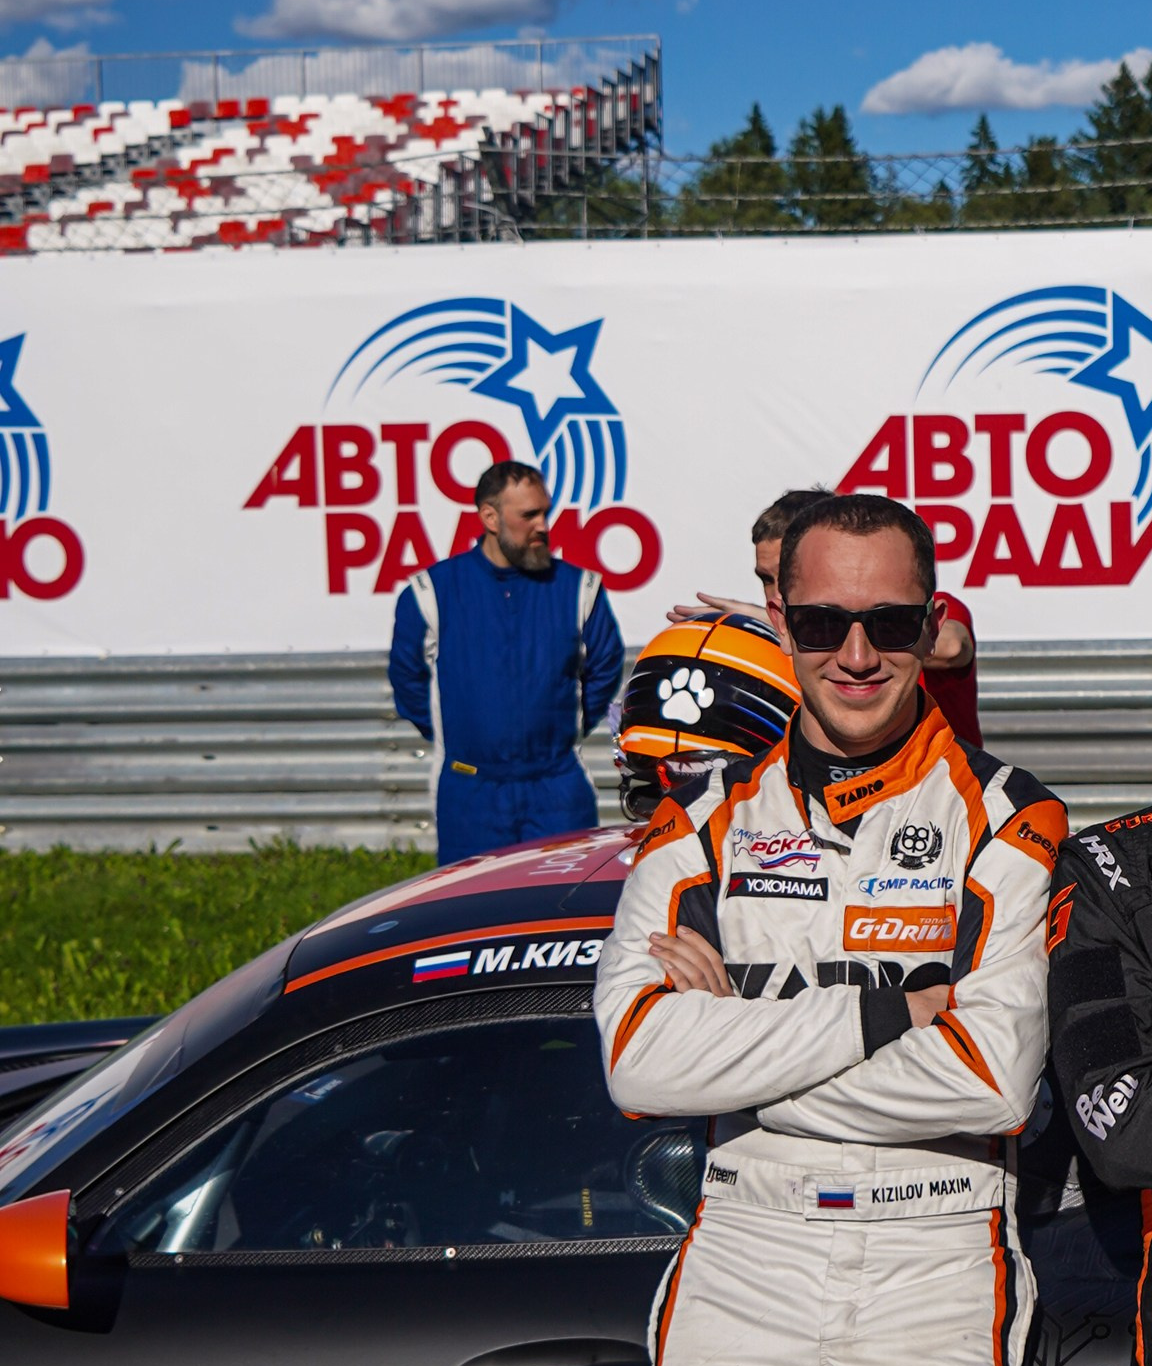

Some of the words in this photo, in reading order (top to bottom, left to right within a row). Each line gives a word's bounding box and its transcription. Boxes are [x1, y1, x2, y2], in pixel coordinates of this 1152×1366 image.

[242, 420, 513, 510] АВТО
[835, 410, 1114, 500] АВТО
[834, 779, 885, 808] YADRO
[1079, 835, 1131, 891] HRX
[746, 878, 824, 897] YOKOHAMA
[877, 878, 908, 892] SMP
[472, 938, 606, 976] М.КИЗ
[1076, 1084, 1105, 1128] Be
[1086, 1074, 1139, 1141] Well
[872, 1182, 924, 1204] KIZILOV
[929, 1176, 972, 1197] MAXIM
